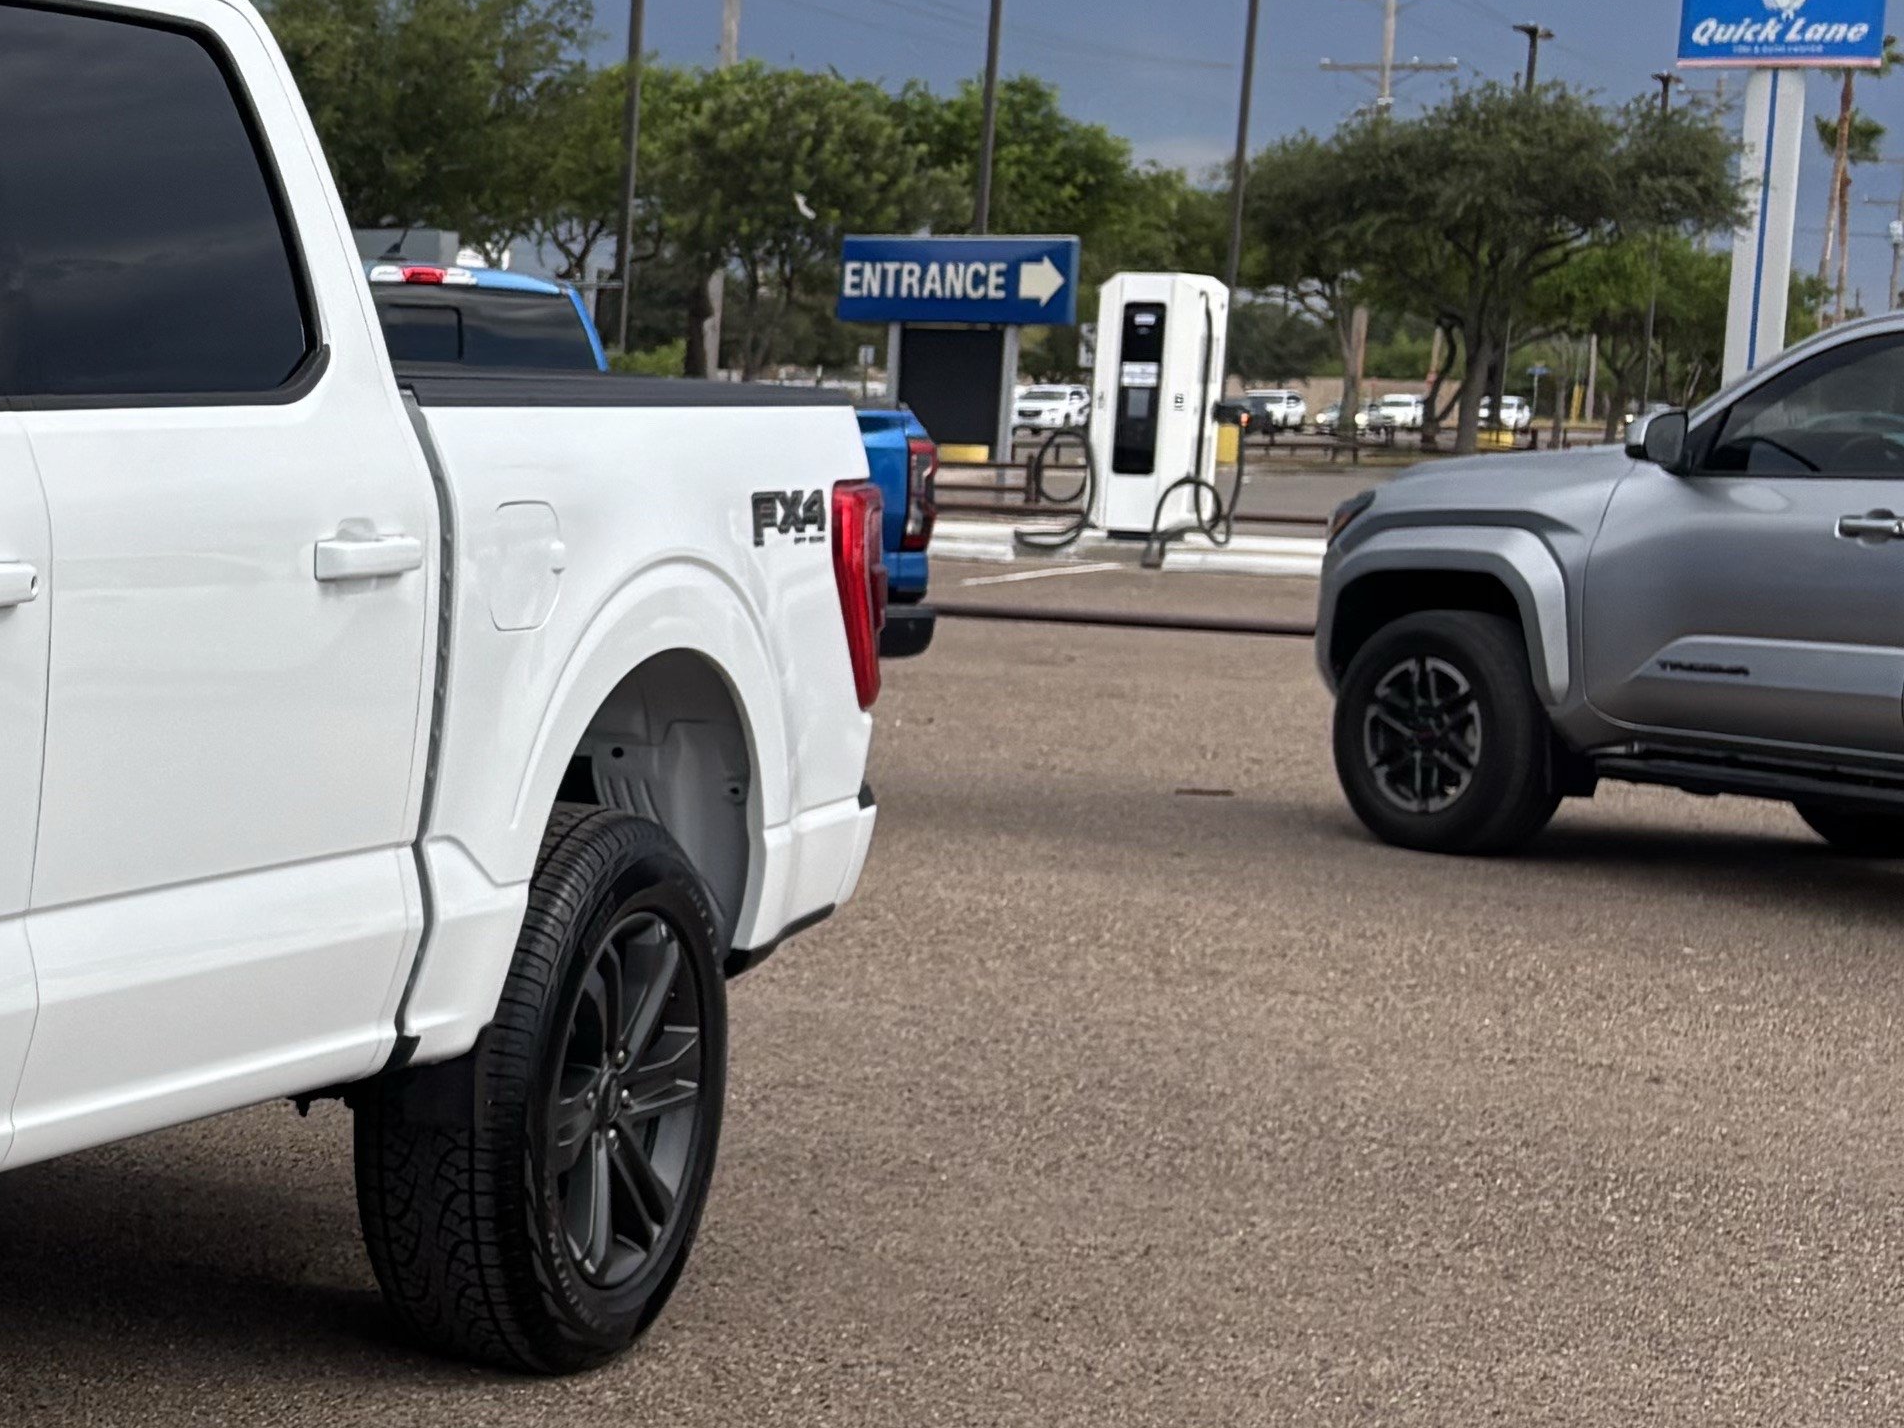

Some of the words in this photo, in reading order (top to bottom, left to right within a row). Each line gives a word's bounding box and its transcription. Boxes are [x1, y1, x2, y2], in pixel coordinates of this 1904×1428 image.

[1691, 17, 1783, 46] Quick
[1784, 18, 1870, 43] Lane
[843, 260, 1008, 299] ENTRANCE
[751, 488, 826, 547] FX4
